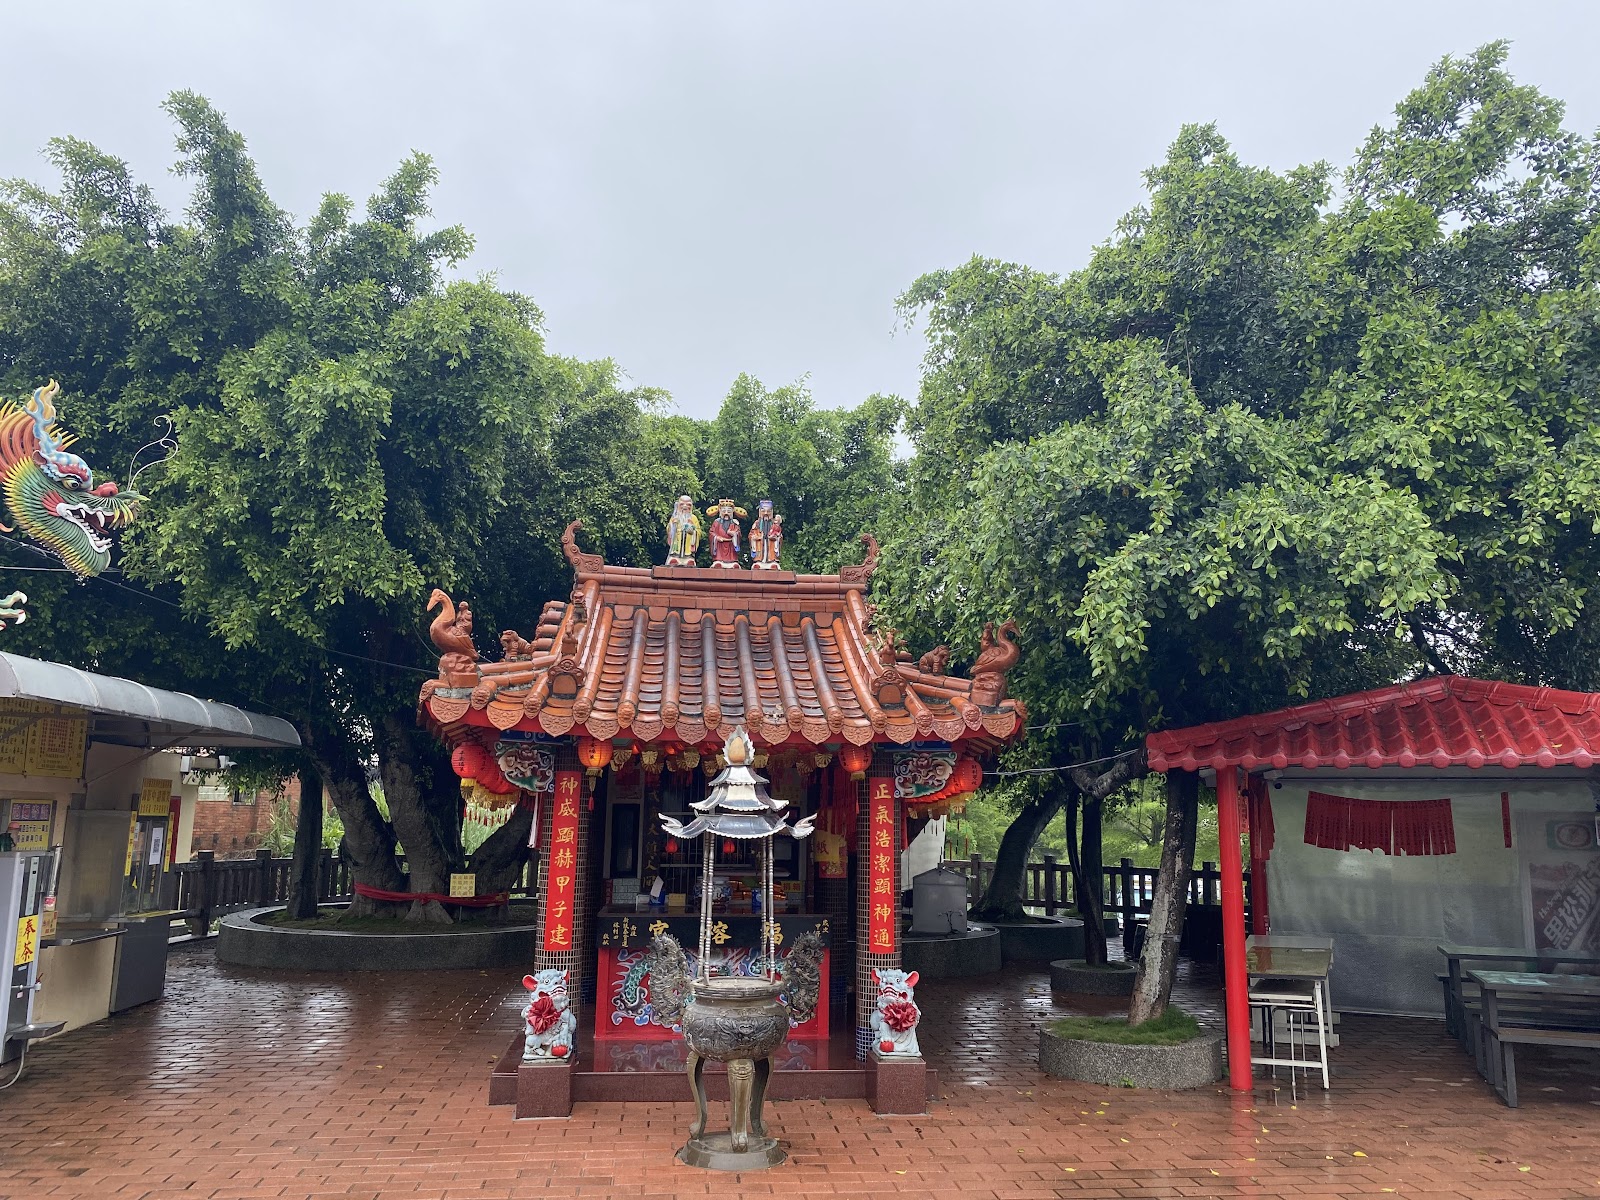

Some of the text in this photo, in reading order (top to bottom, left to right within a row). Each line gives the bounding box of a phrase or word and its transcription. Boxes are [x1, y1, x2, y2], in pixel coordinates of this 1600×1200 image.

[21, 919, 36, 962] 奉茶
[550, 777, 578, 945] 神威顯赫甲子建
[873, 783, 893, 947] 正氣浩潔顯神通
